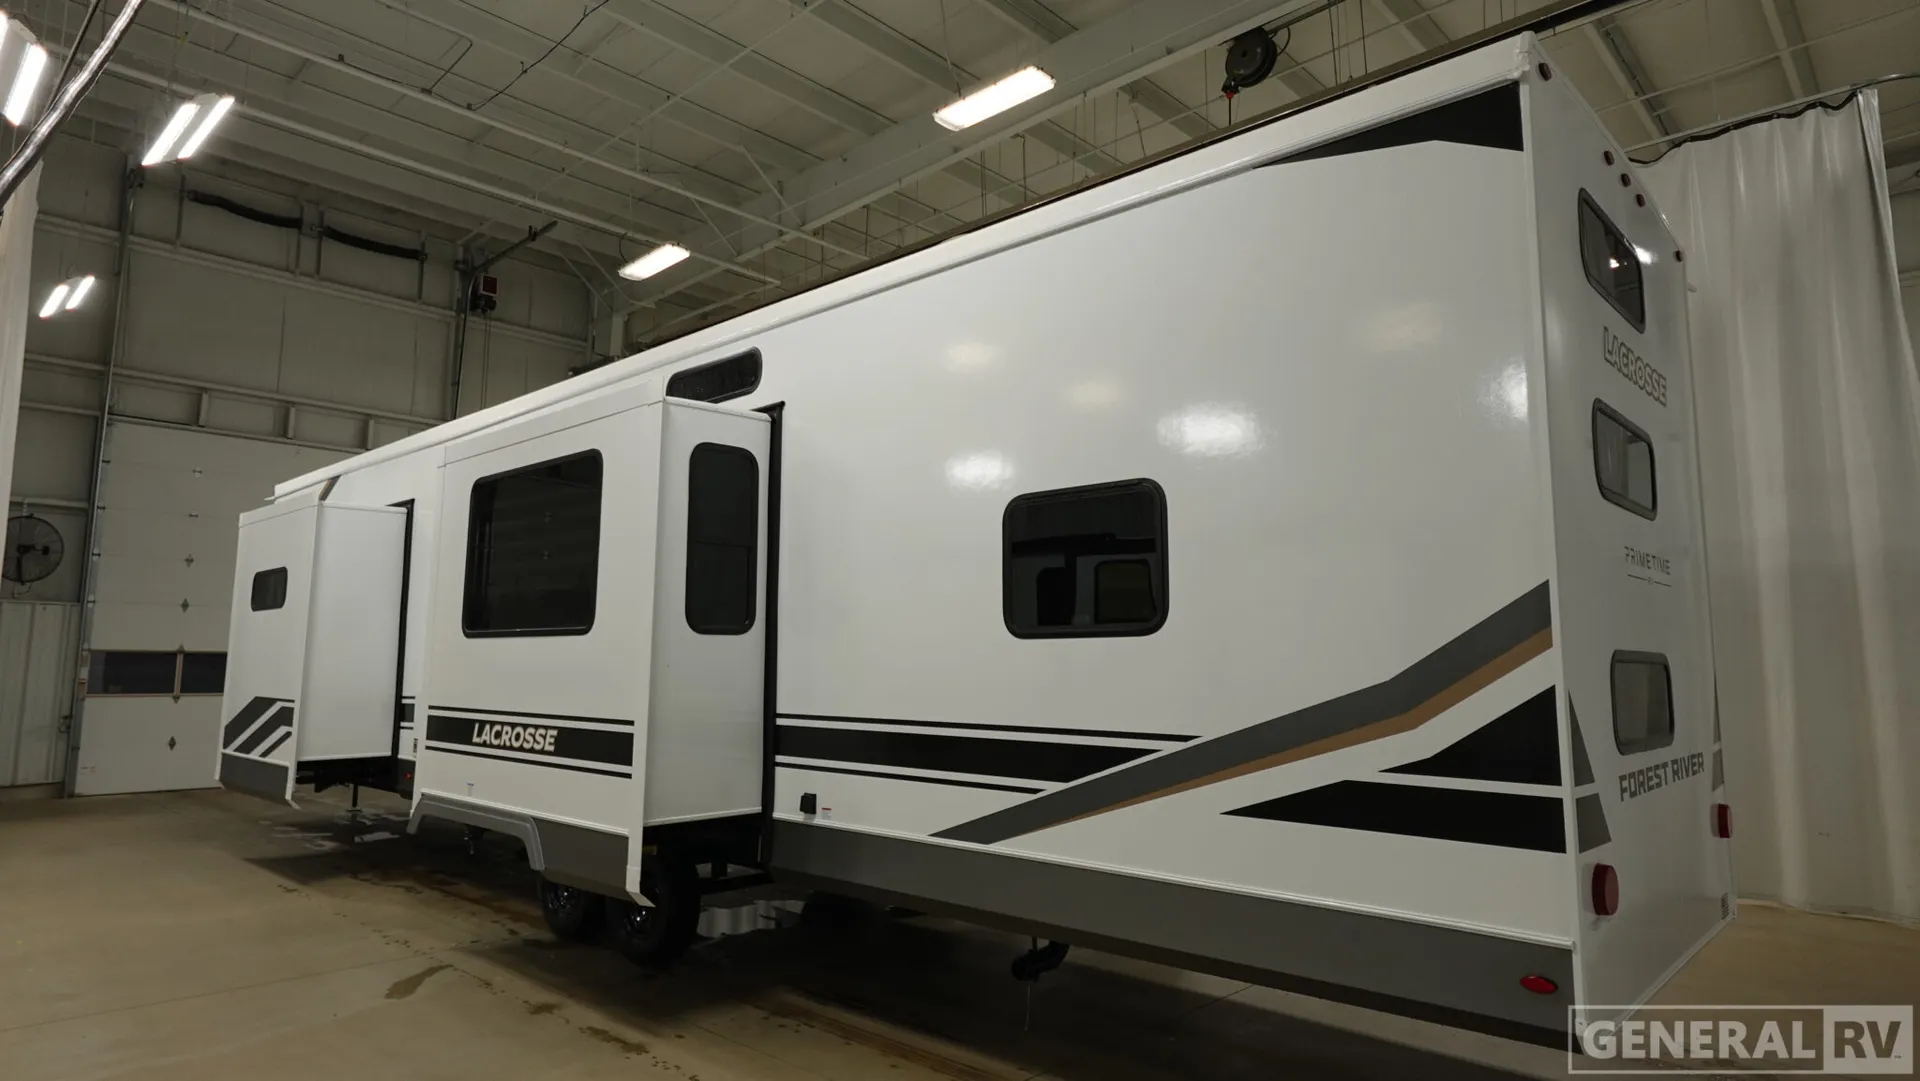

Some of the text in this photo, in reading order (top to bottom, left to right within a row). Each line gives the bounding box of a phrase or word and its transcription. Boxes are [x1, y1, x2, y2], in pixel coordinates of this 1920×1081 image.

[1603, 325, 1667, 408] LACROSSE
[472, 722, 558, 752] LACROSSE
[1618, 752, 1705, 802] FOREST RIVER
